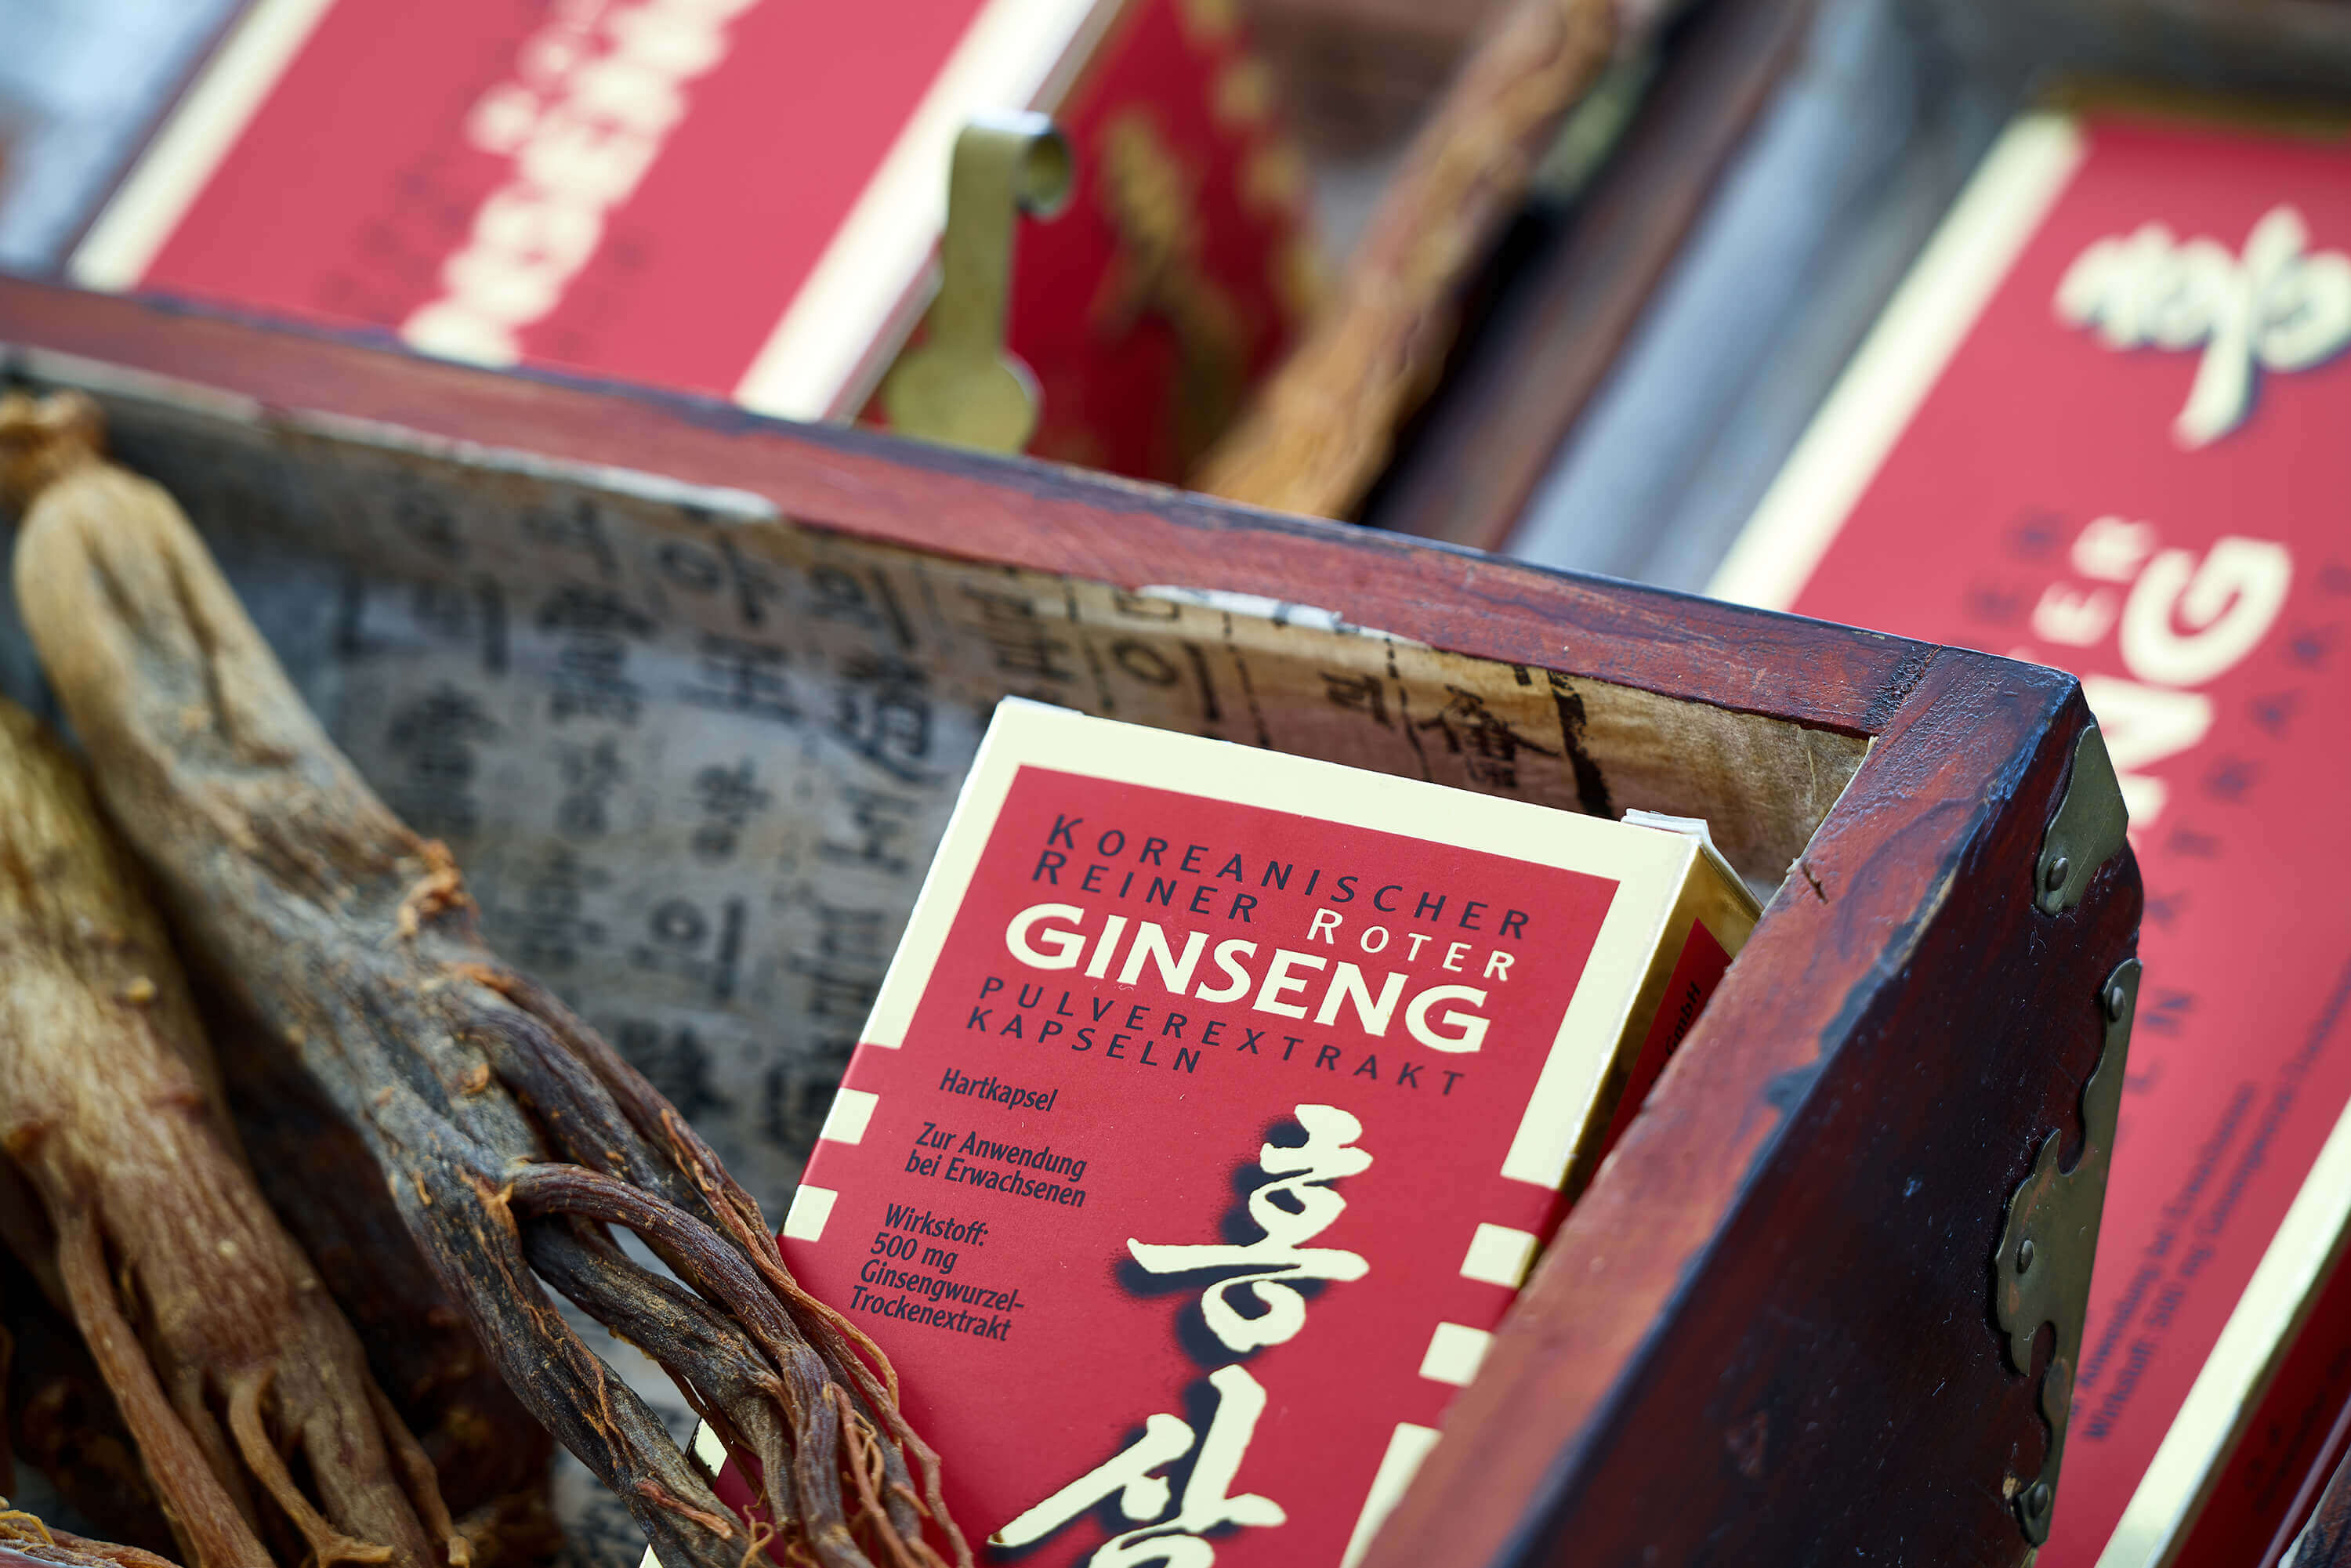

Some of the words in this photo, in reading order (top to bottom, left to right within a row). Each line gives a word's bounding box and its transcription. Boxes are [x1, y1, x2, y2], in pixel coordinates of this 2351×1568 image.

[1047, 814, 1529, 940] KOREANISCHER
[1031, 850, 1258, 923] REINER
[1306, 907, 1516, 982] ROTER
[1005, 903, 1491, 1054] GINSENG
[966, 1006, 1201, 1074] KAPSELN
[979, 976, 1463, 1095] PULVEREXTRAKT
[939, 1067, 1059, 1112] Hartkapsel
[904, 1149, 943, 1177] bei
[944, 1157, 1086, 1208] Erwachsenen
[915, 1121, 957, 1150] Zur
[954, 1131, 1088, 1182] Anwendung
[870, 1231, 918, 1261] 500
[921, 1247, 959, 1275] mg
[885, 1203, 989, 1247] Wirkstoff:
[849, 1284, 1012, 1342] Trockenextrakt
[860, 1259, 1024, 1313] Ginsengwurzel-
